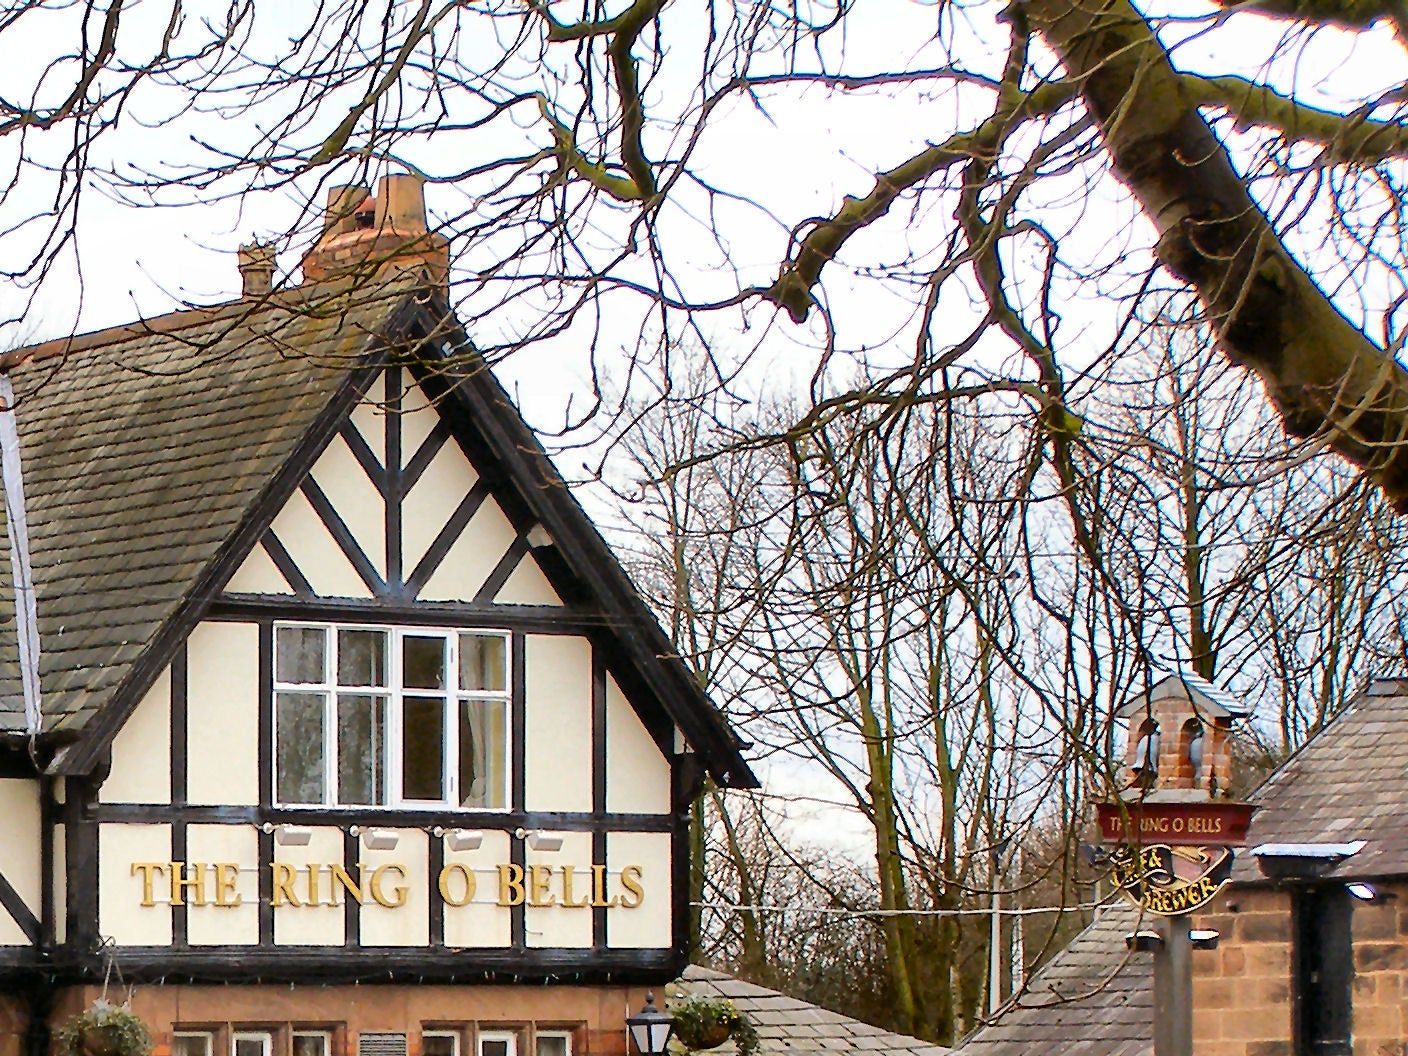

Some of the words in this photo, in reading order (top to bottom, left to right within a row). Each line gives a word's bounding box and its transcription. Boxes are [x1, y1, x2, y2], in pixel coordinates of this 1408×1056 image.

[1172, 817, 1184, 833] O
[1187, 817, 1222, 834] BELLS
[130, 860, 242, 908] THE
[268, 862, 410, 908] RING
[438, 862, 477, 907] O
[496, 863, 645, 908] BELLS
